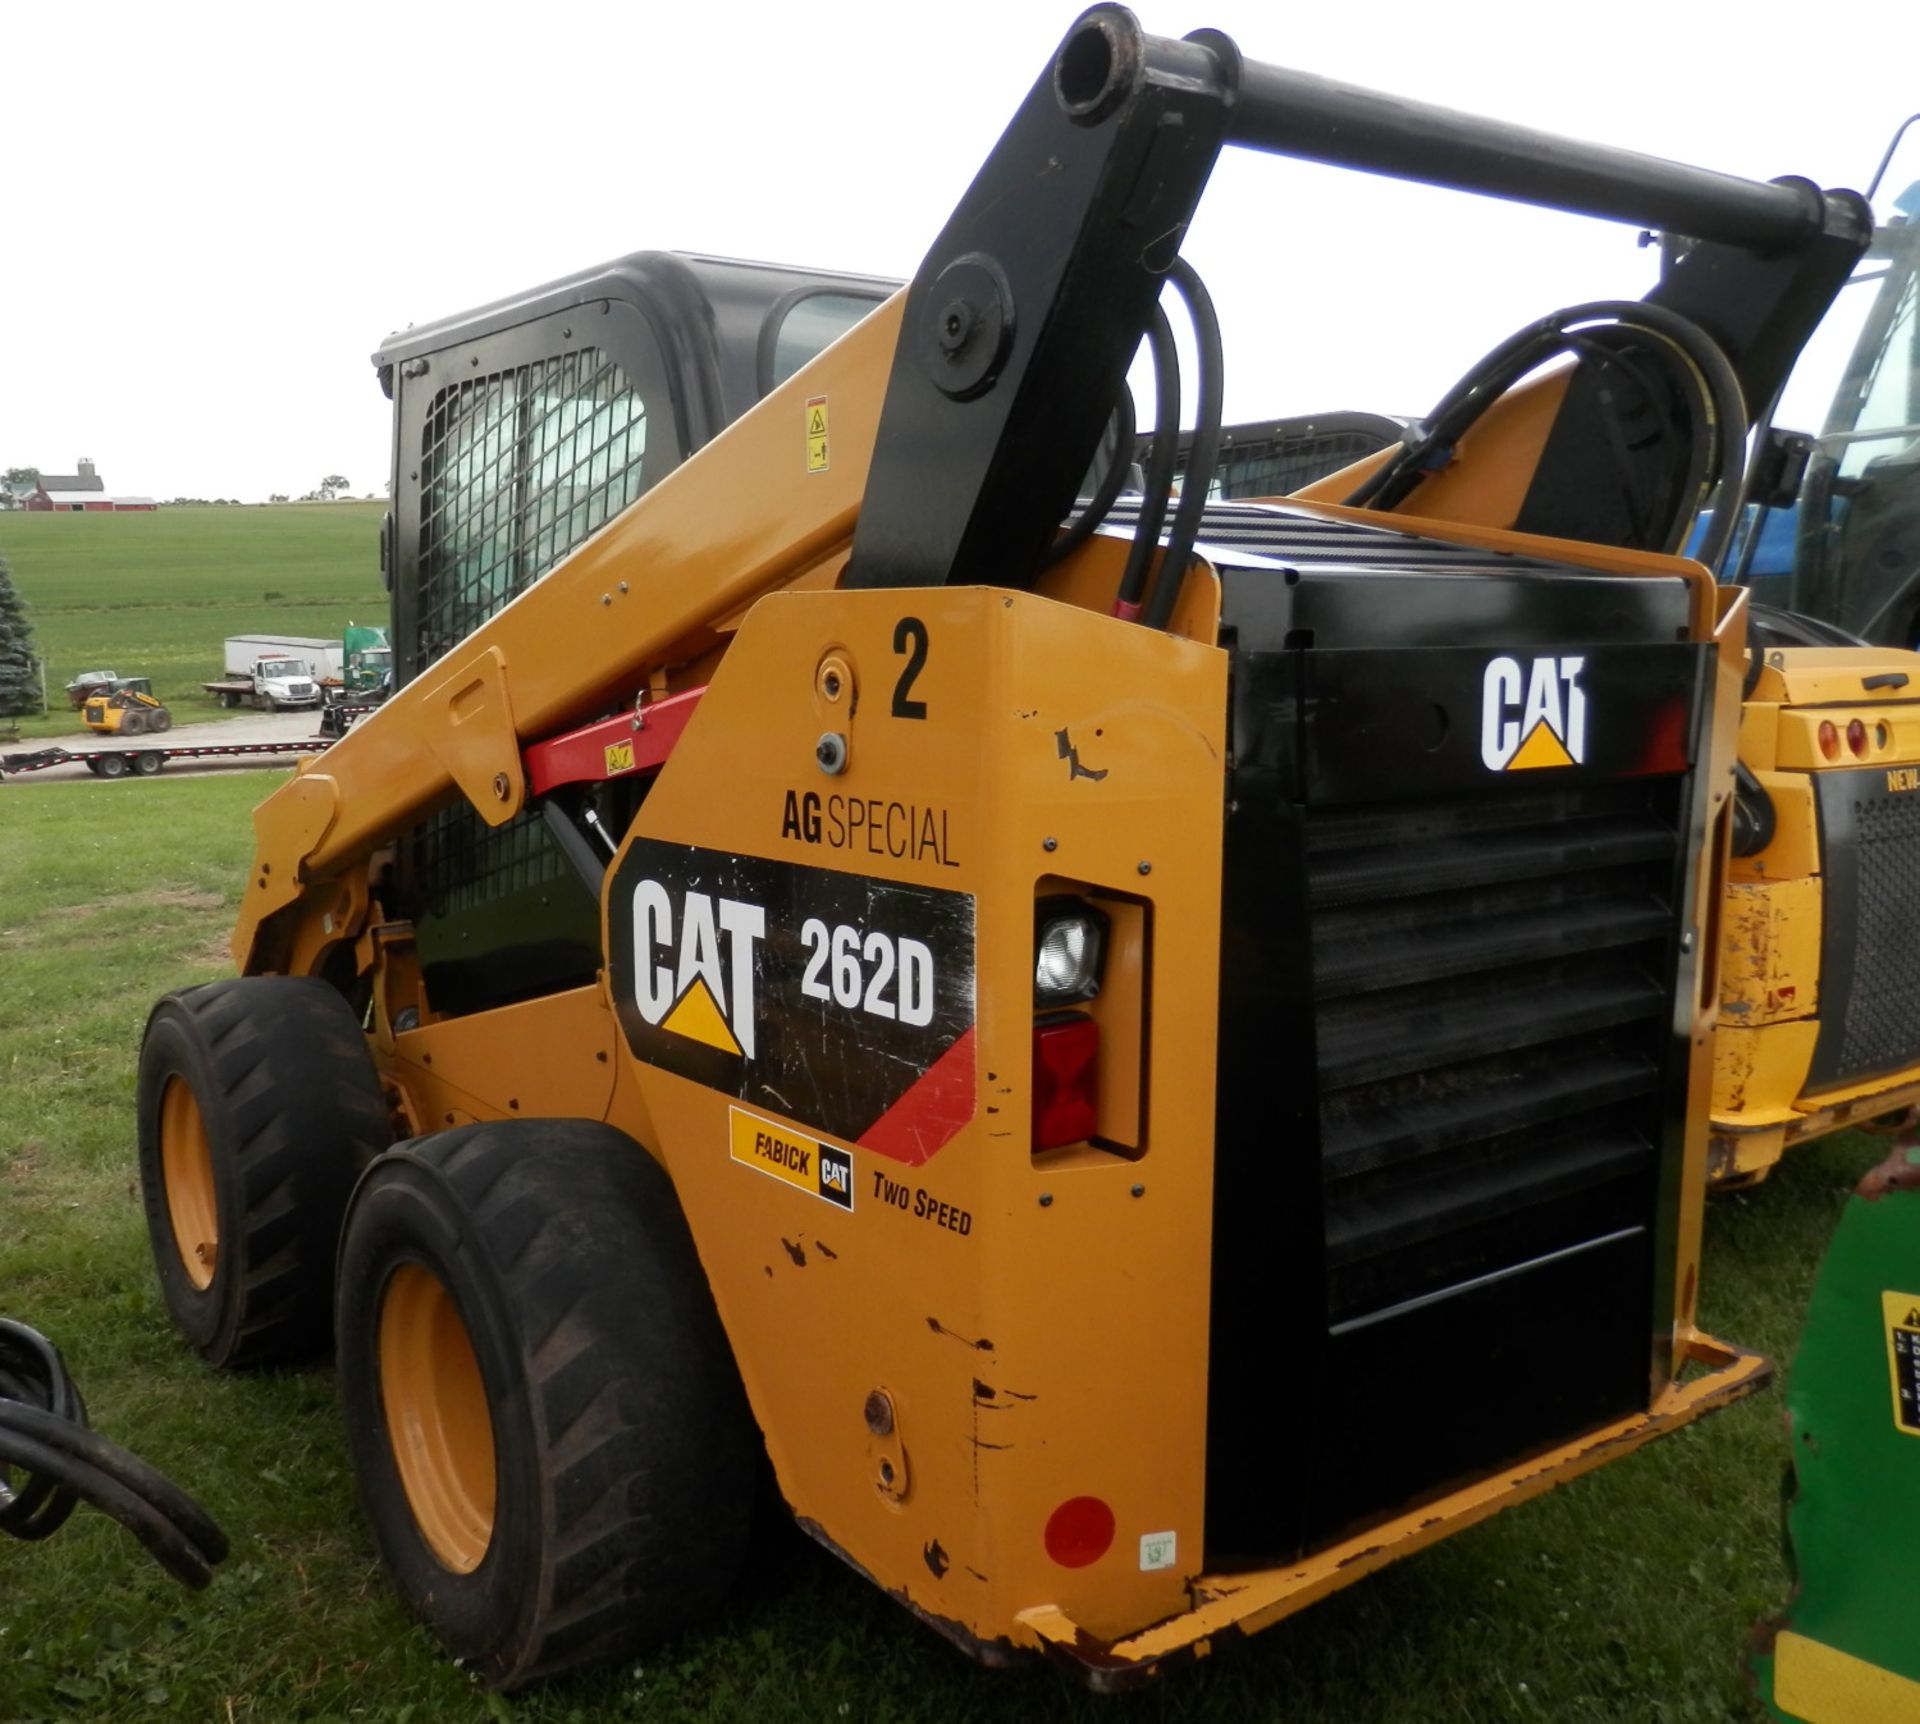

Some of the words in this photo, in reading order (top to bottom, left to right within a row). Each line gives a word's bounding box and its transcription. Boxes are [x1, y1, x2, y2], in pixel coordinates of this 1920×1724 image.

[891, 616, 929, 720] 2
[1481, 655, 1588, 772] CAT
[782, 790, 821, 844] AG
[827, 794, 961, 867] SPECIAL
[632, 879, 765, 1060] CAT
[800, 918, 934, 1027] 262D
[754, 1132, 810, 1176] FABICK
[821, 1157, 849, 1193] CAT
[873, 1171, 910, 1209] TWO
[914, 1187, 972, 1236] SPEED
